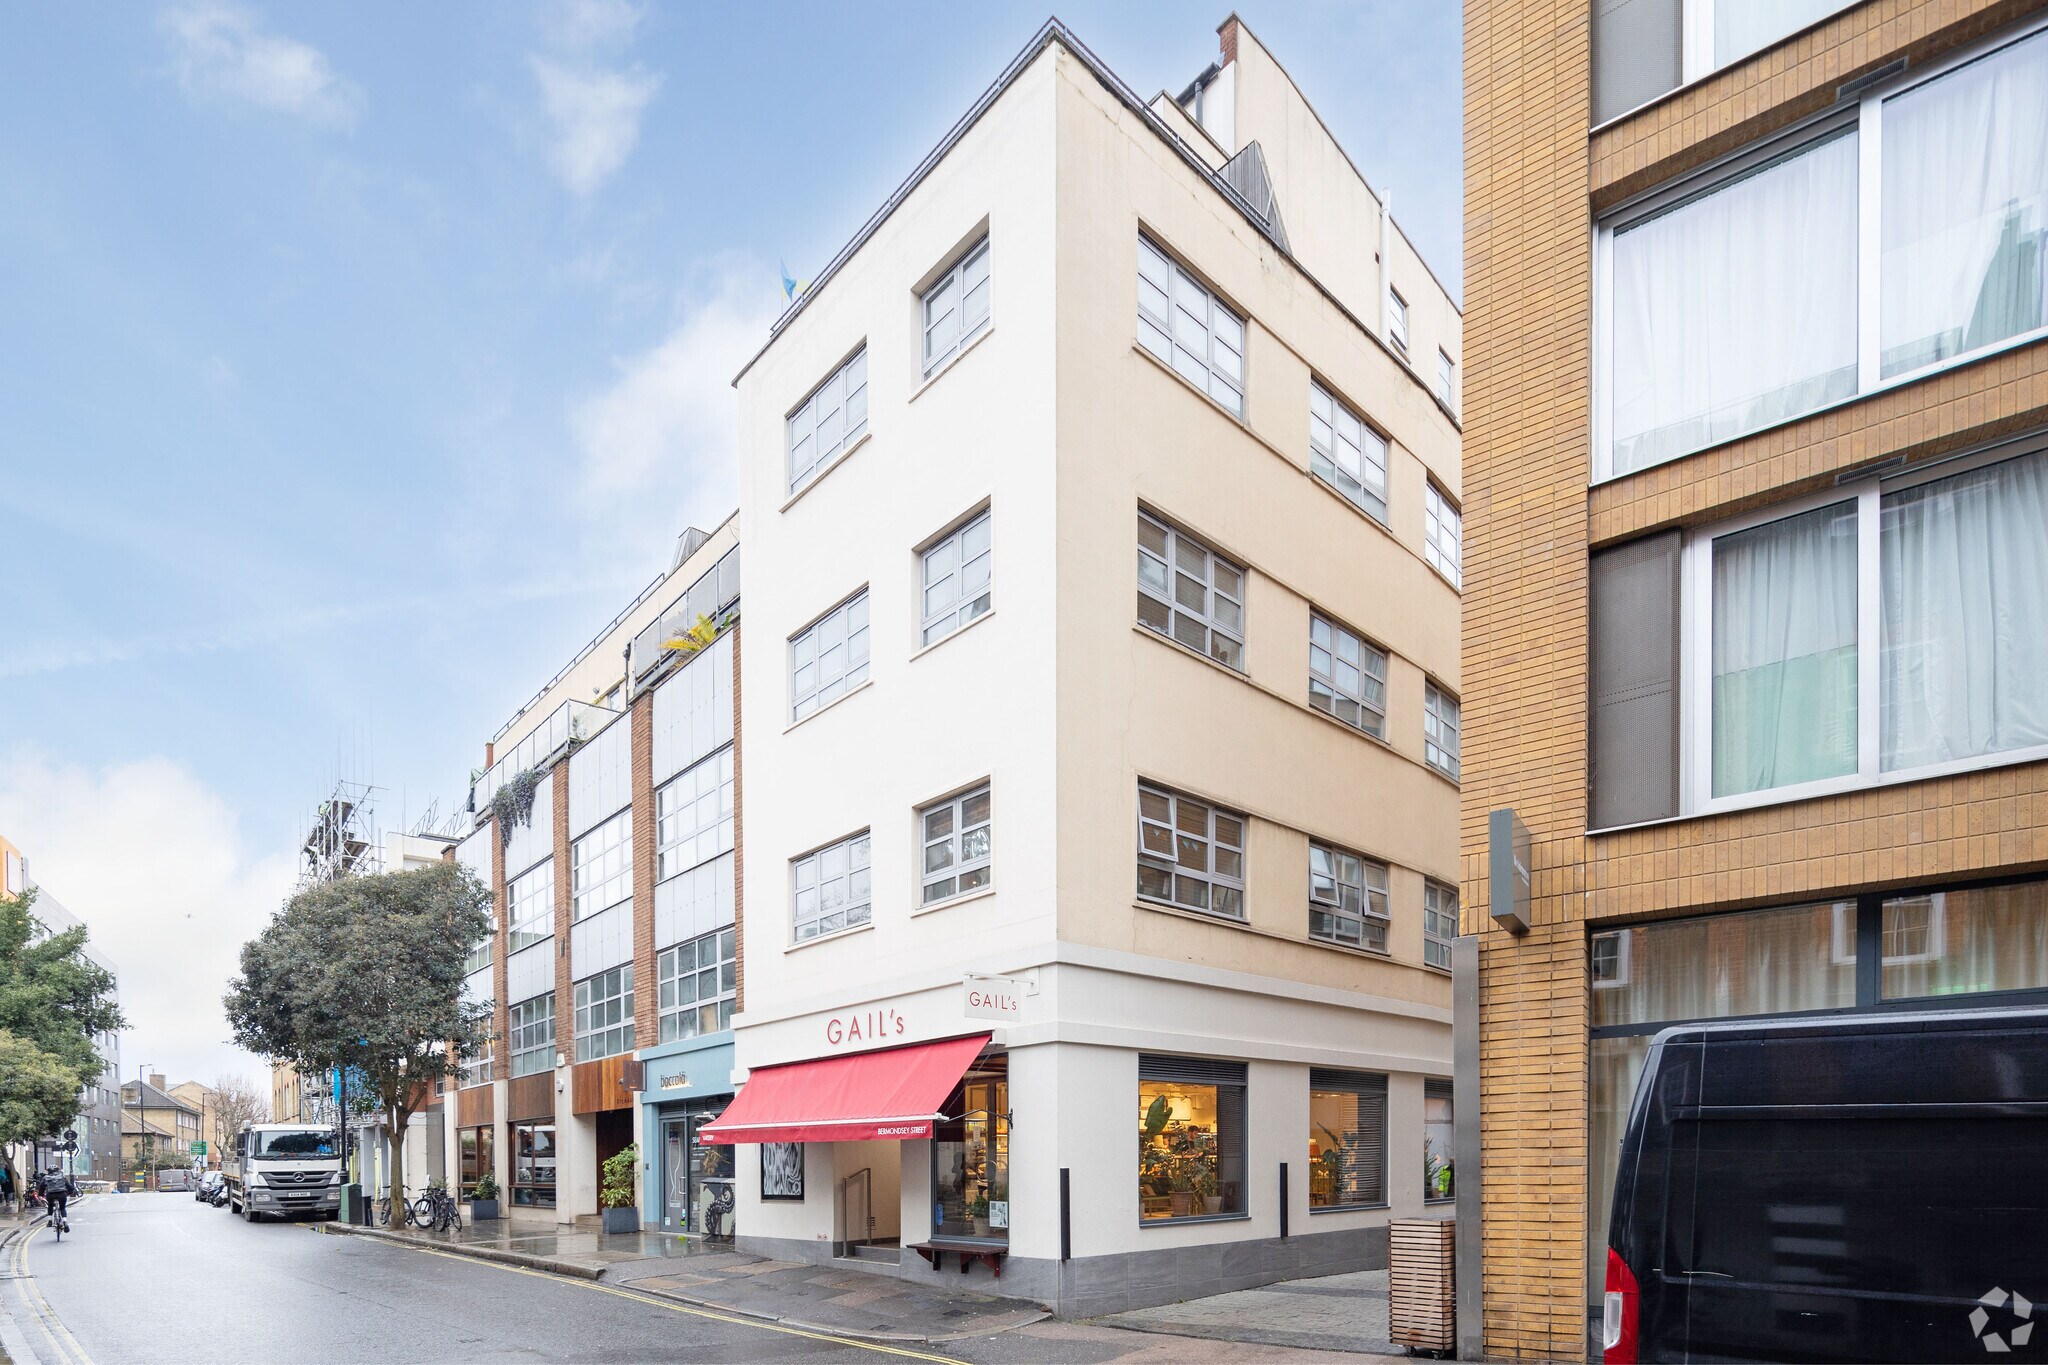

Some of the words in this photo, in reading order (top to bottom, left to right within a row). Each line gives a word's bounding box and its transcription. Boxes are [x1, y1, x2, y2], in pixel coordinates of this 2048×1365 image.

[969, 991, 1017, 1011] GAIL's
[827, 1009, 905, 1044] GAIL's
[877, 1126, 909, 1135] BERMONDSEY
[910, 1126, 927, 1134] STREET
